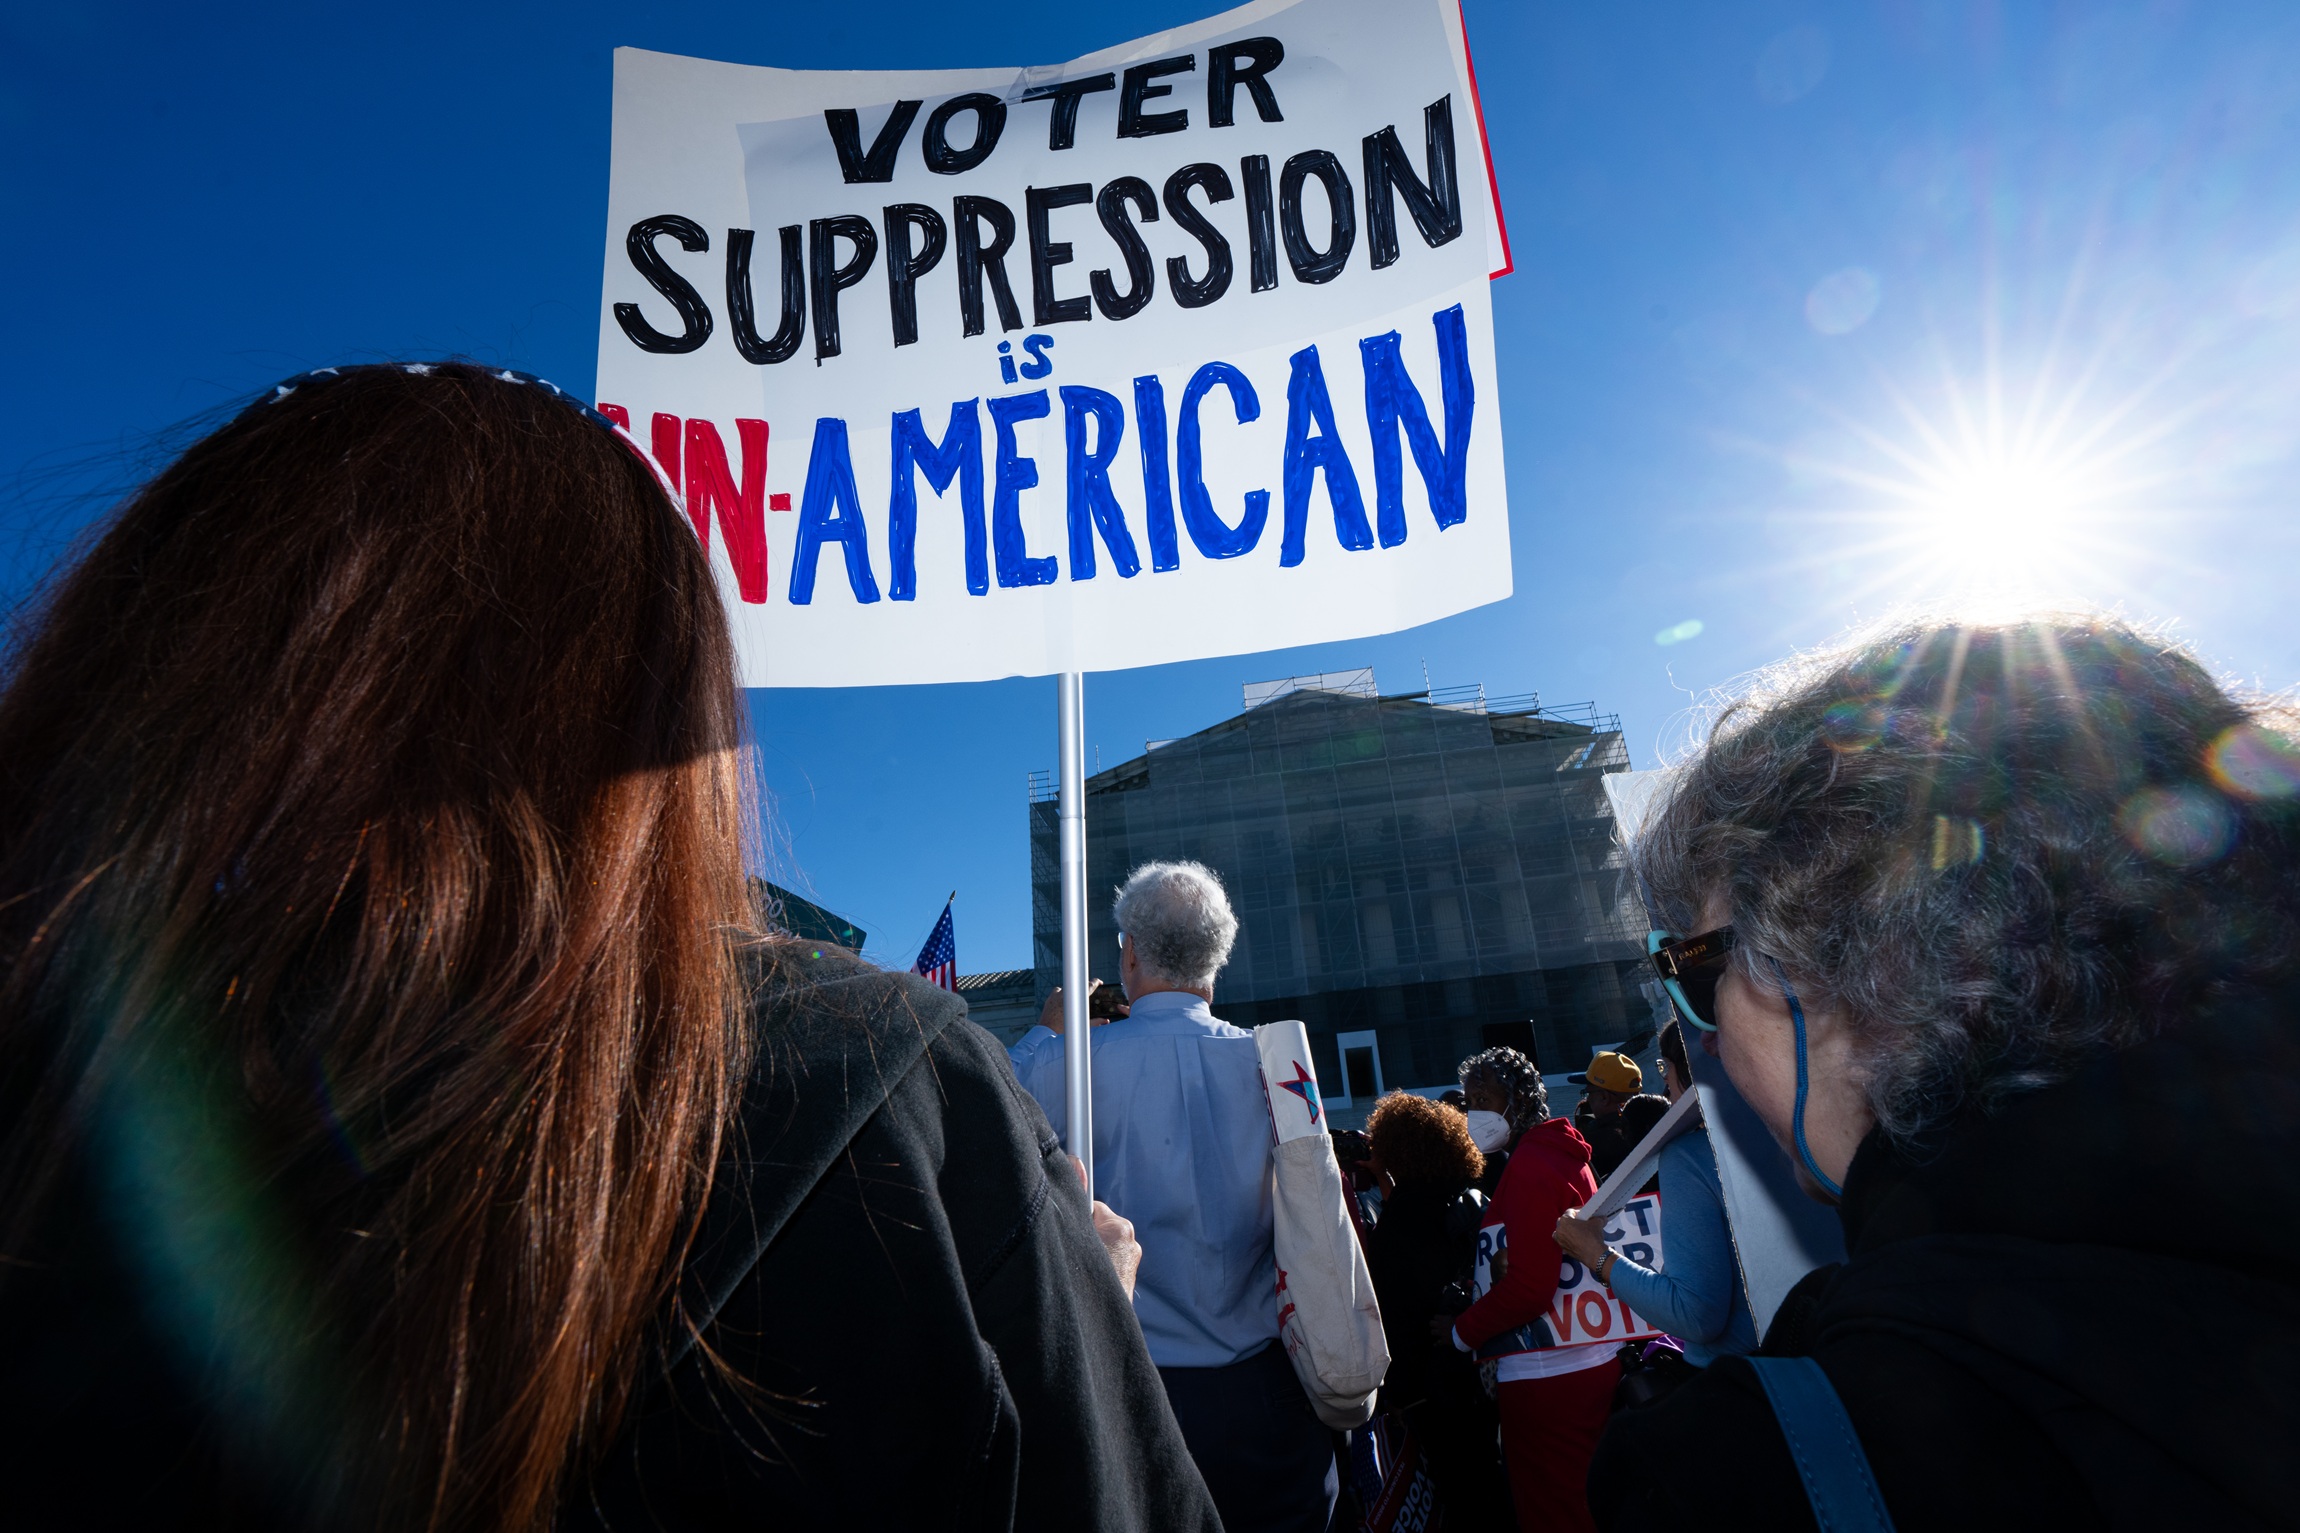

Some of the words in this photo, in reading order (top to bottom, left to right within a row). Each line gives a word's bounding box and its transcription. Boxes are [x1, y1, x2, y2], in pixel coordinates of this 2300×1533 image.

[824, 36, 1285, 183] VOTER
[613, 93, 1463, 366] SUPPRESSION
[1558, 1241, 1658, 1290] OR
[1548, 1290, 1660, 1342] VOT
[1391, 1470, 1426, 1533] VOICE
